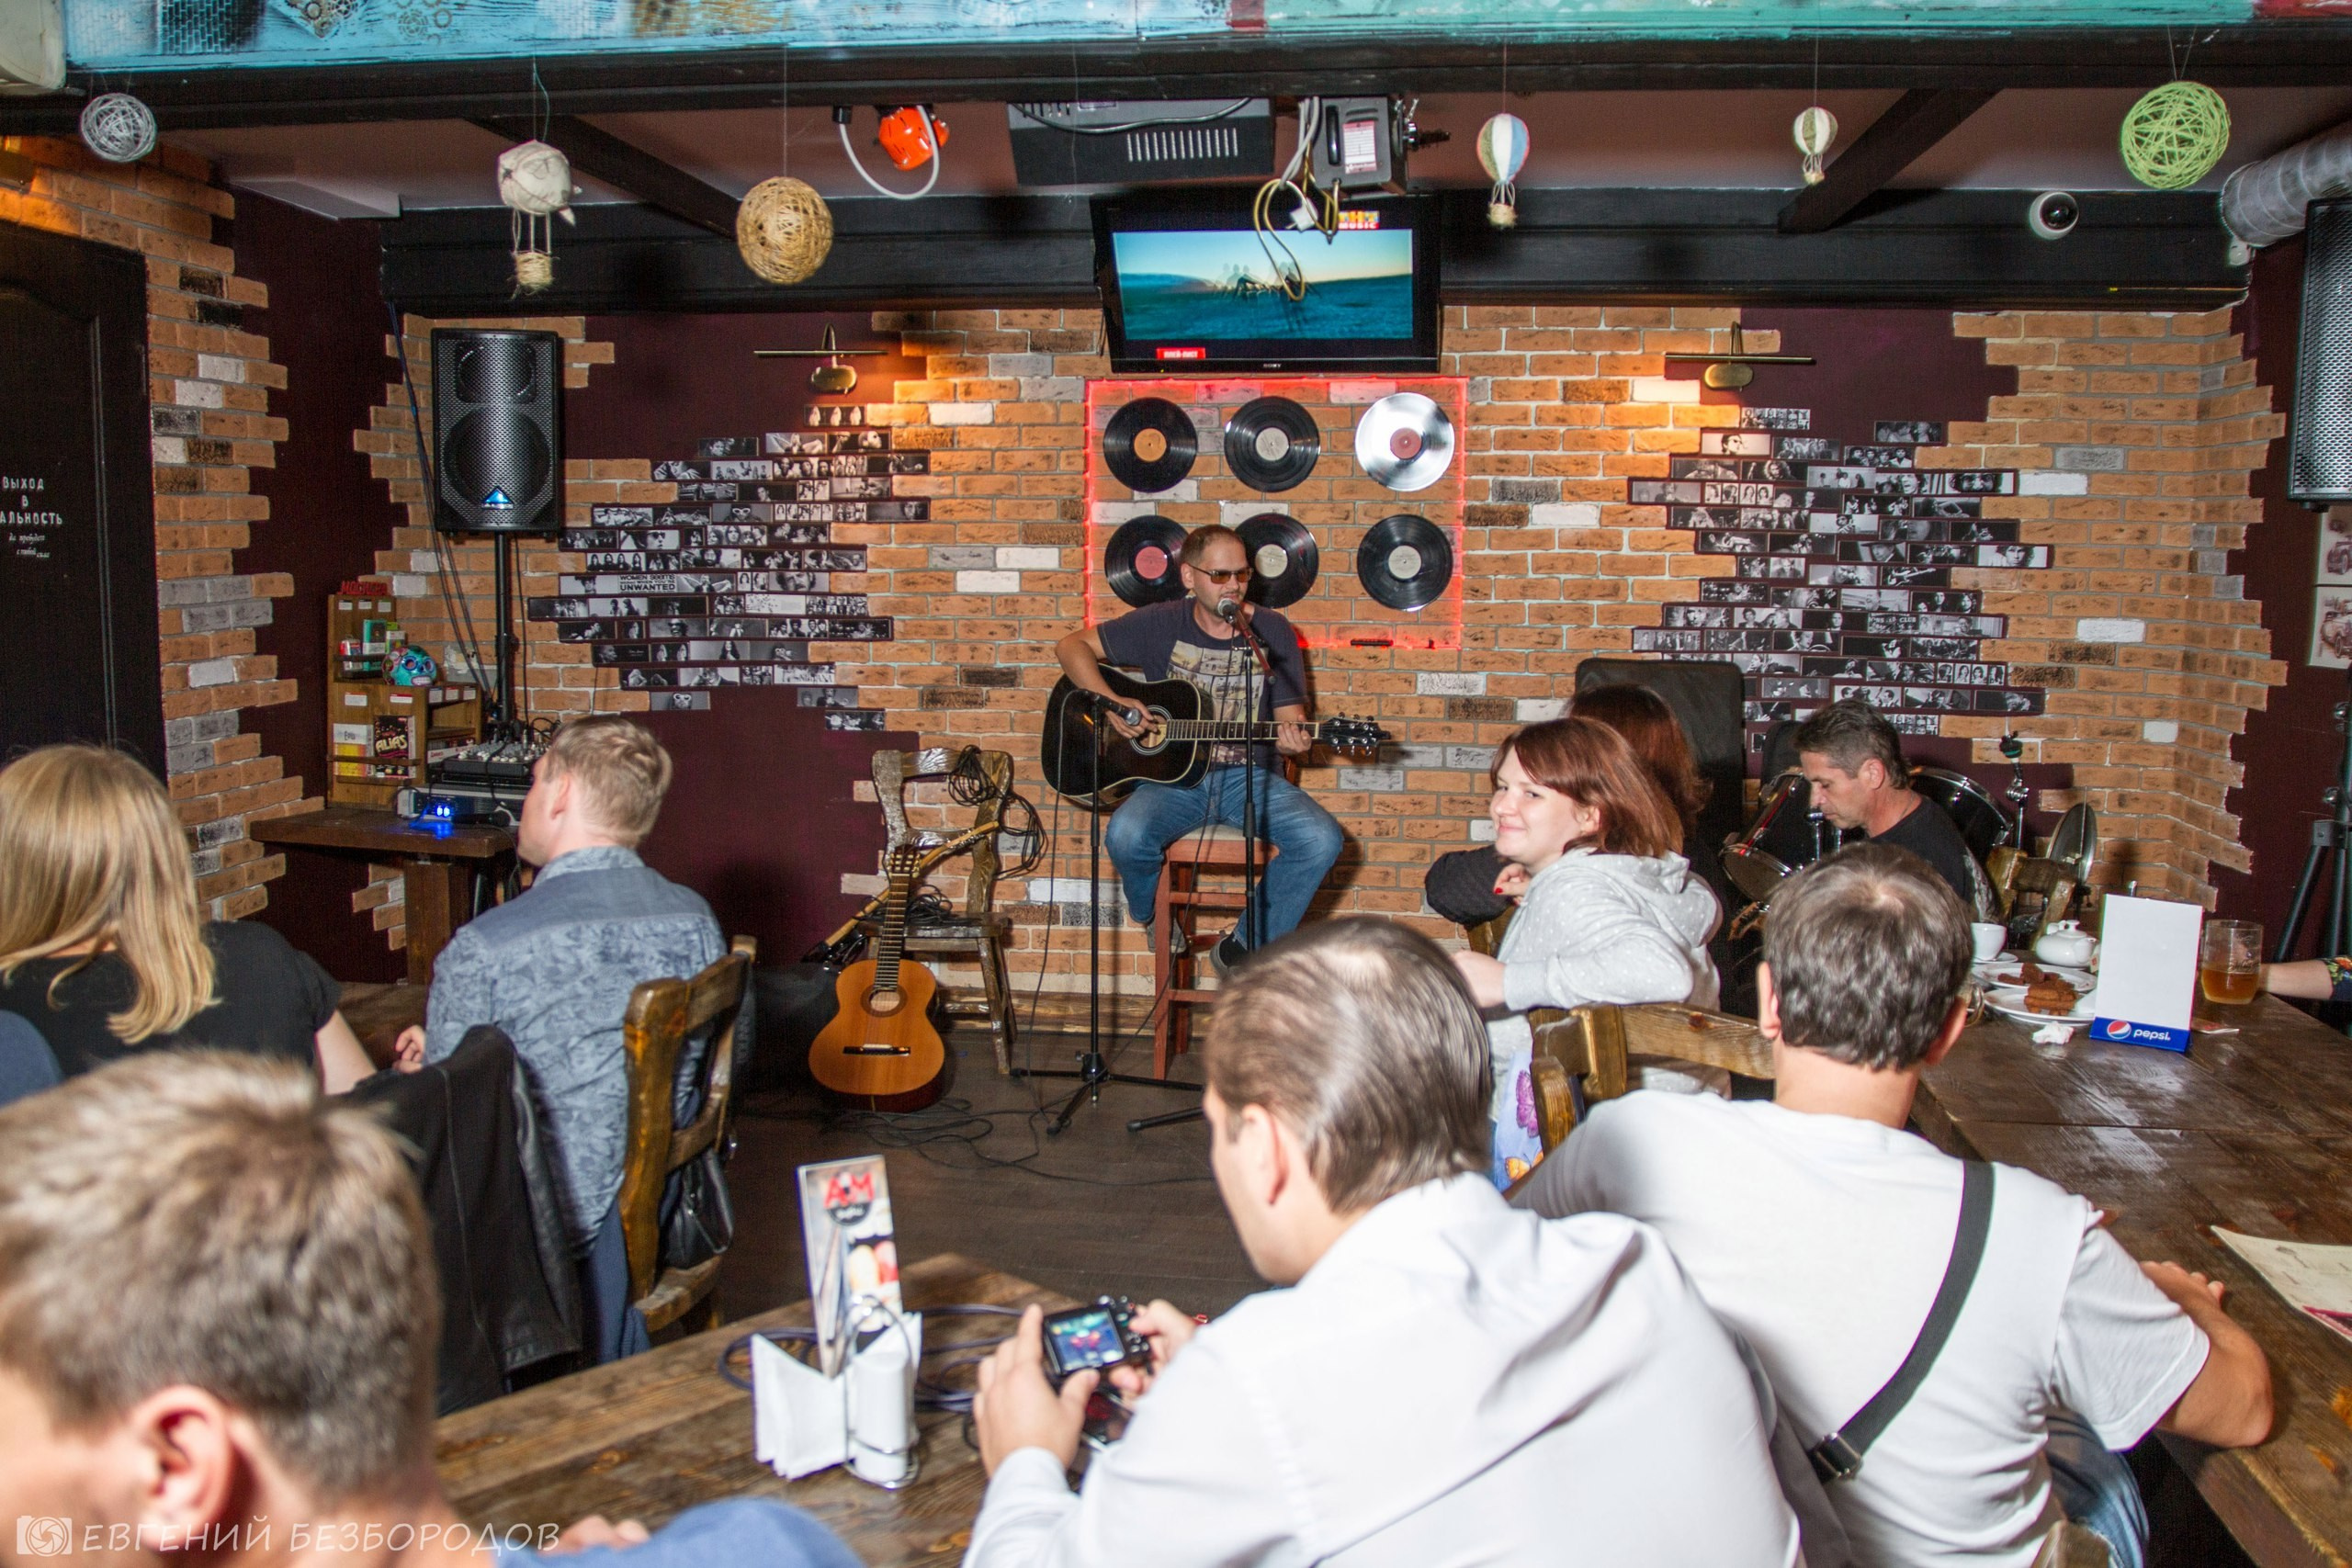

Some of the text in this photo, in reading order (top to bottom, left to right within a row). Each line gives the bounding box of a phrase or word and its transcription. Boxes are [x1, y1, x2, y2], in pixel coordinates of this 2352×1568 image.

[2, 476, 44, 491] ВЫХОД
[21, 494, 29, 507] В
[375, 734, 409, 753] ALIAS
[2132, 1029, 2171, 1041] pepsi
